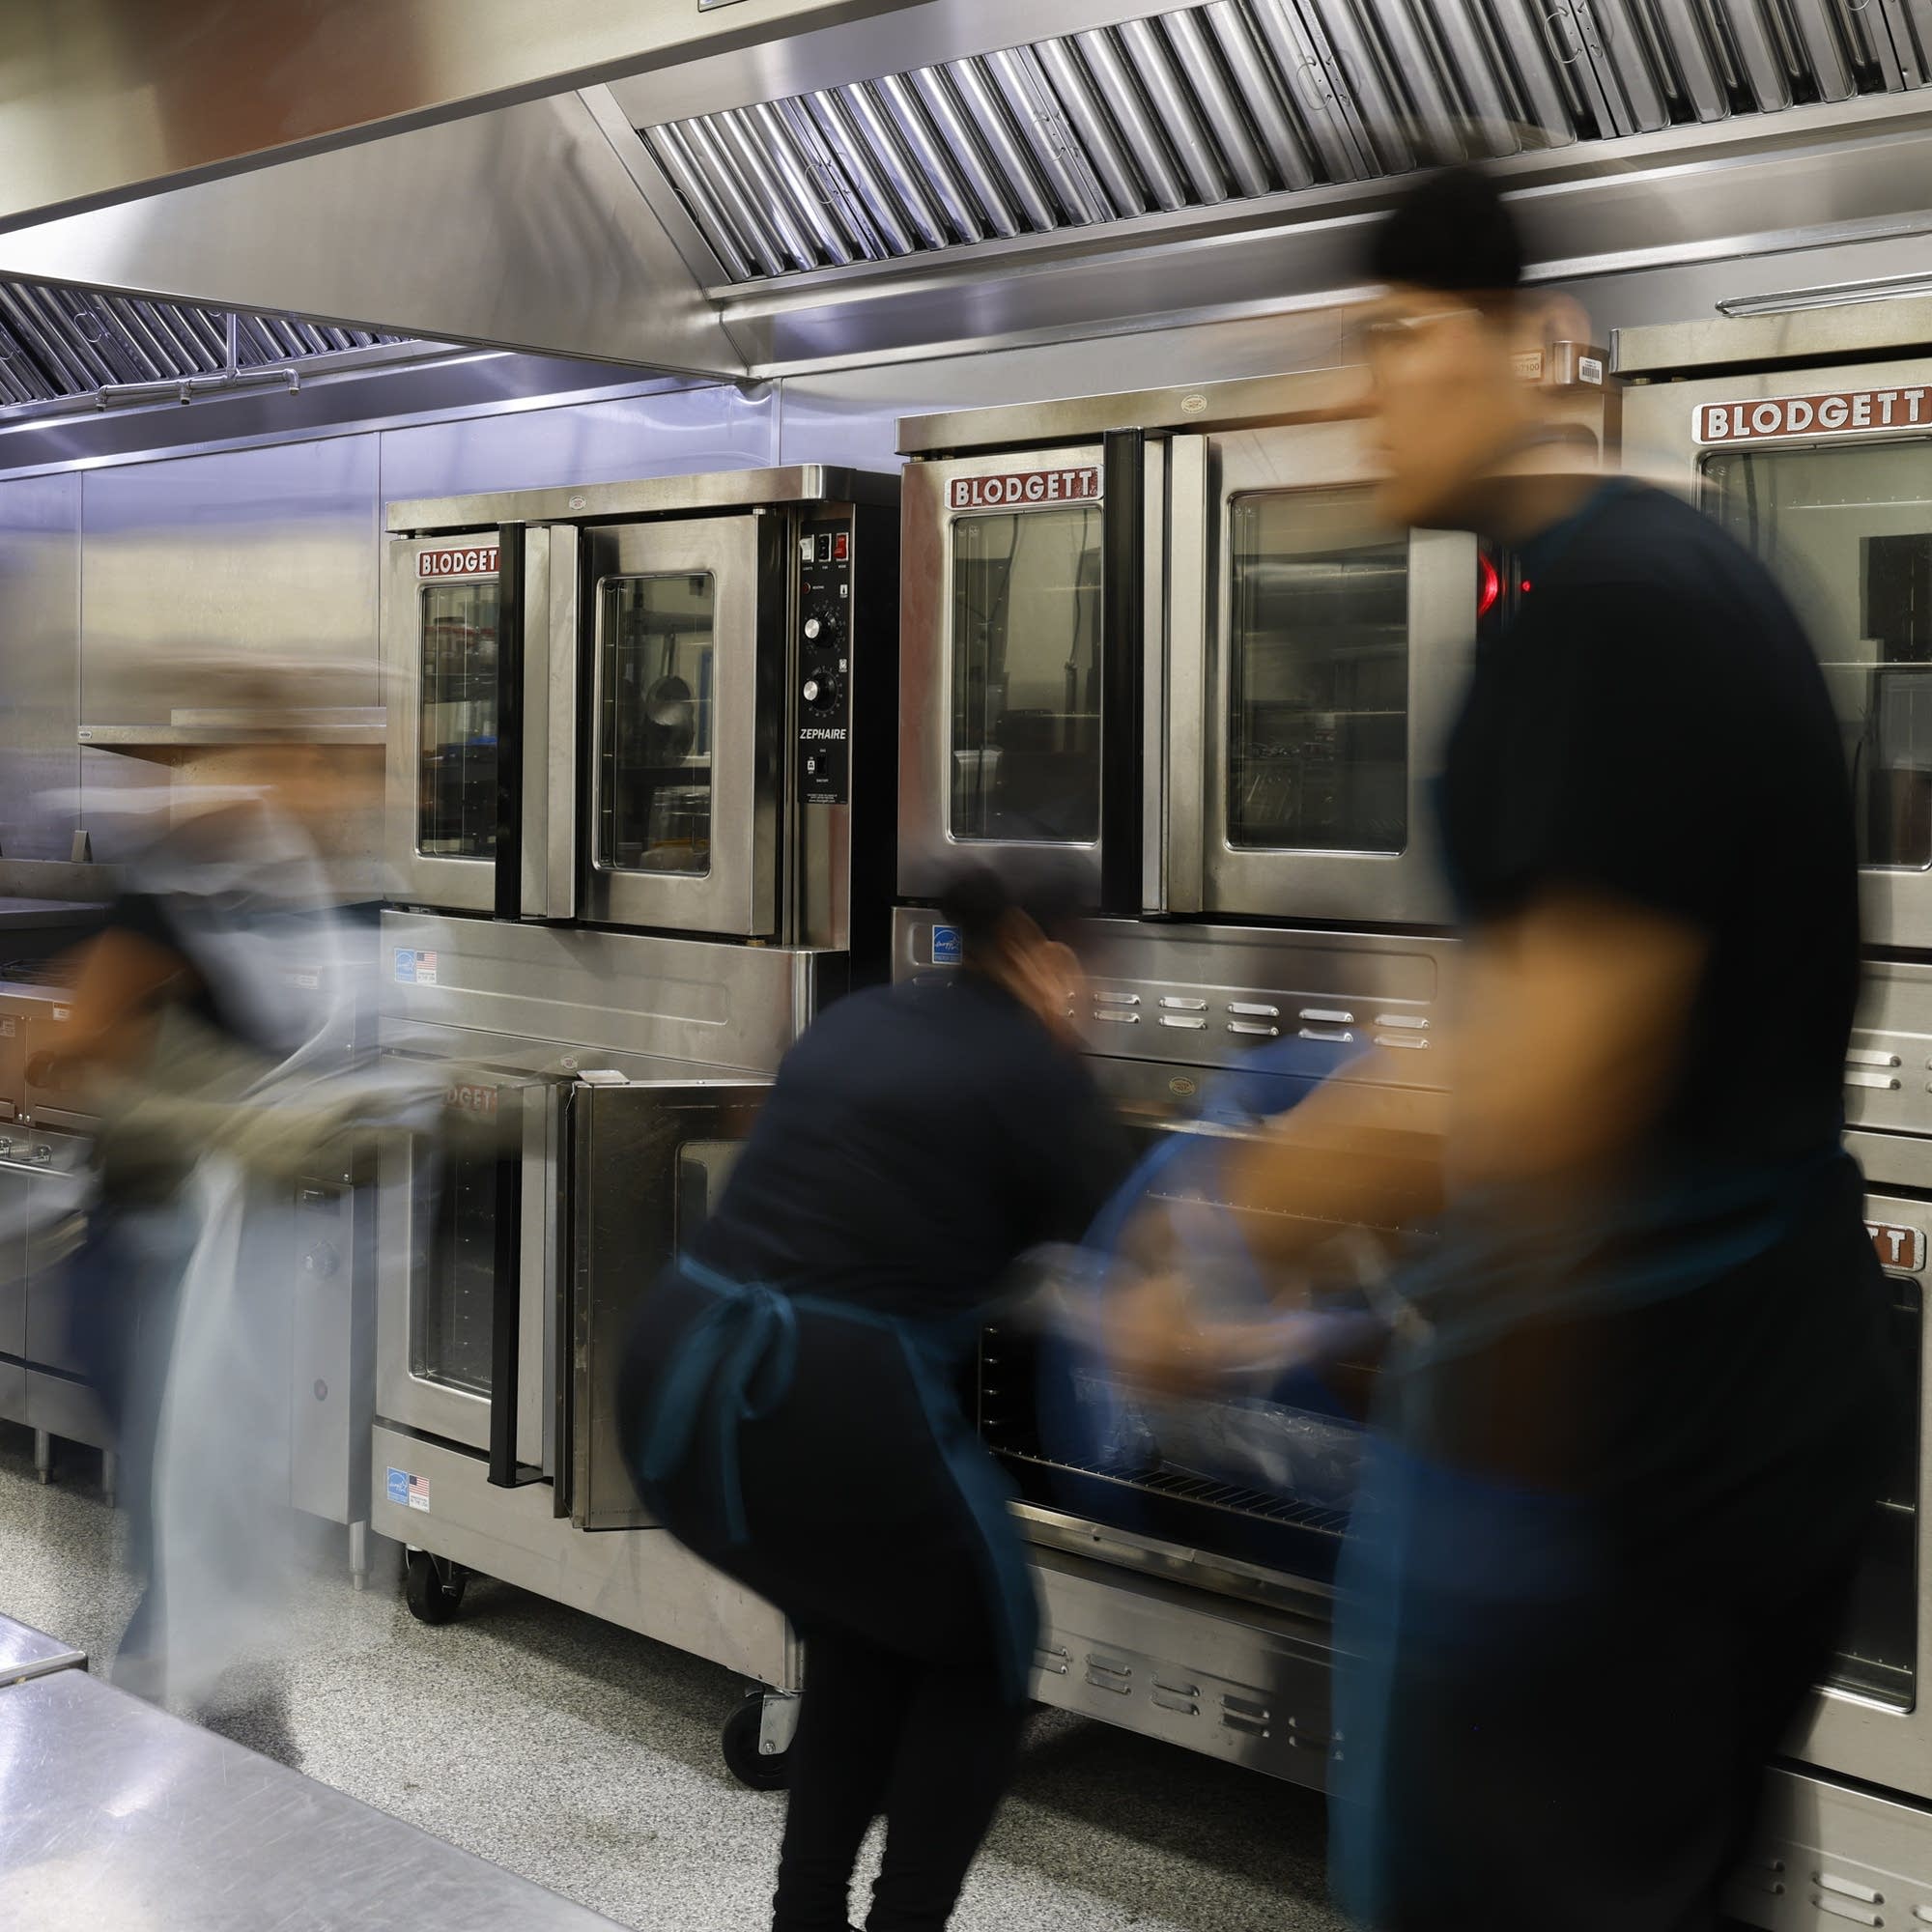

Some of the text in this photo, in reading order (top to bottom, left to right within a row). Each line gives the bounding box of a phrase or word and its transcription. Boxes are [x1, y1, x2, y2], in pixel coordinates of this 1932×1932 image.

[1708, 389, 1925, 439] BLODGETT
[955, 470, 1093, 506] BLODGETT
[422, 550, 497, 575] BLODGET
[799, 728, 847, 740] ZEPHAIRE
